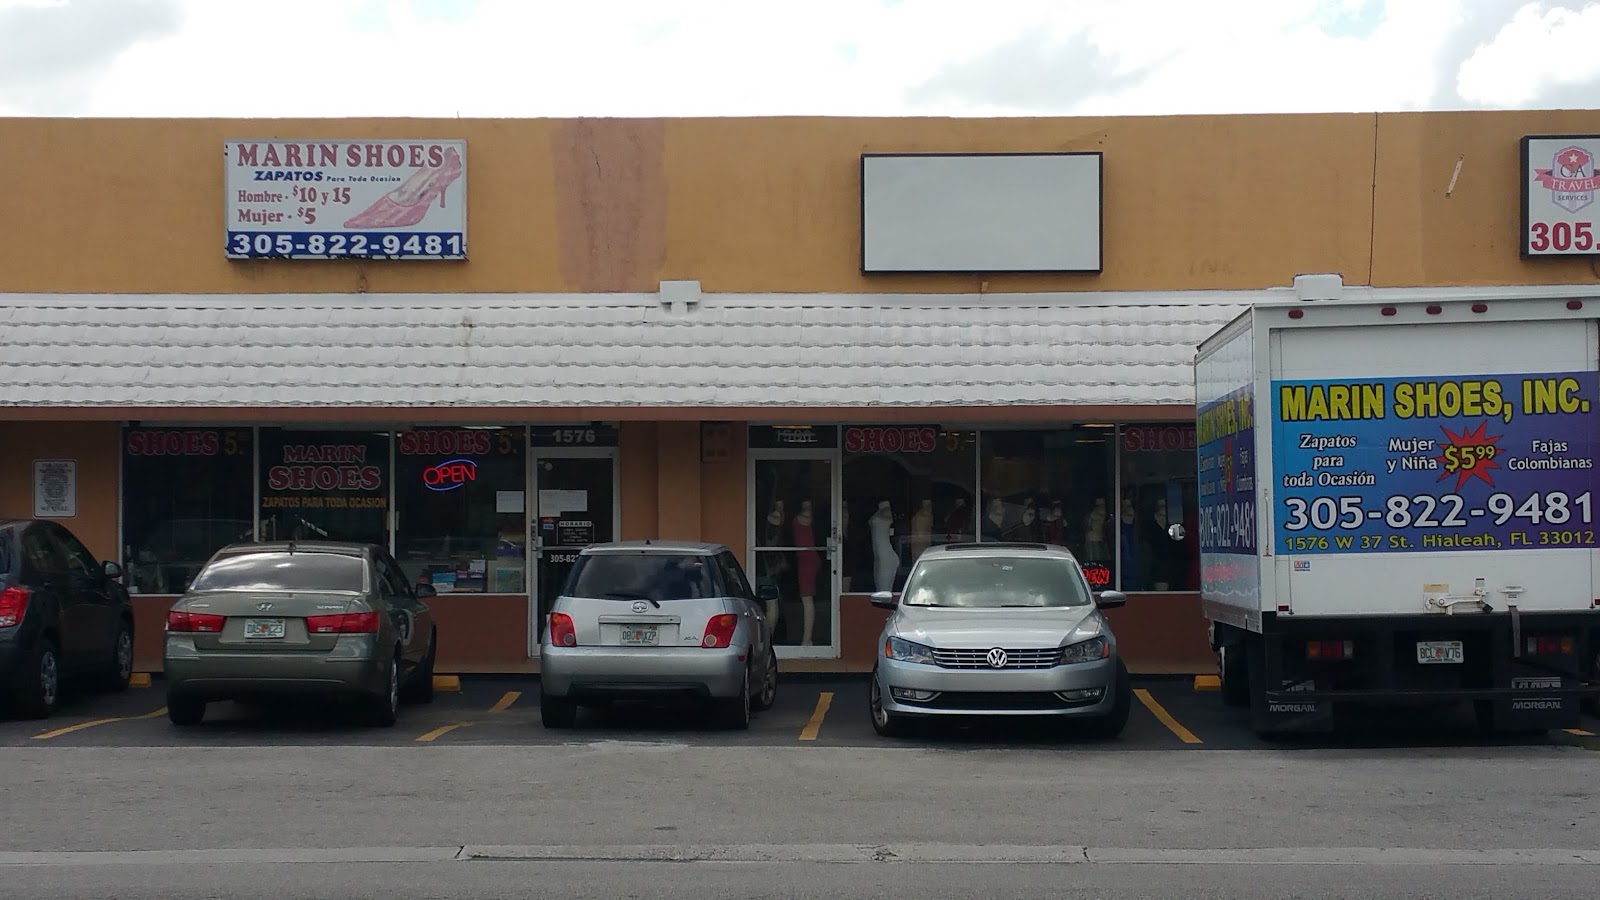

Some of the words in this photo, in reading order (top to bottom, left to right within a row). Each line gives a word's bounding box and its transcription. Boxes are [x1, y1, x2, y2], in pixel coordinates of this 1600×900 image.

[237, 144, 338, 167] MARIN
[346, 144, 443, 167] SHOES
[253, 171, 323, 182] ZAPATOS
[1551, 179, 1598, 192] TRAVEL
[238, 189, 283, 203] Hombre
[292, 185, 317, 203] $10
[321, 191, 329, 205] y
[332, 187, 351, 204] 15
[238, 209, 284, 226] Mujer
[297, 207, 316, 225] $5
[233, 235, 462, 254] 305-822-9481
[1280, 384, 1385, 422] MARIN
[1394, 379, 1513, 423] SHOES,
[1522, 378, 1590, 416] INC.
[127, 430, 219, 456] SHOES
[400, 430, 490, 455] SHOES
[552, 429, 596, 443] 1576
[845, 427, 936, 453] SHOES
[1125, 427, 1196, 452] SHOE
[1300, 434, 1356, 450] Zapatos
[282, 444, 367, 464] MARIN
[1388, 438, 1435, 454] Mujer
[1532, 440, 1568, 454] Fajas
[1312, 455, 1344, 470] para
[1387, 459, 1396, 473] y
[1402, 455, 1437, 471] Niña
[1508, 456, 1593, 471] Colombianas
[268, 465, 381, 491] SHOES
[423, 464, 476, 485] OPEN
[1283, 472, 1313, 488] toda
[1318, 471, 1376, 487] Ocasión
[262, 496, 300, 508] ZAPATOS
[302, 496, 323, 508] PARA
[325, 496, 347, 508] TODA
[349, 496, 386, 508] OCASION
[1285, 491, 1592, 531] 305-822-9481
[1285, 536, 1329, 550] 1576
[1334, 535, 1353, 549] W
[1360, 535, 1382, 549] 37
[1388, 534, 1415, 548] St.
[1422, 532, 1502, 549] Hialeah,
[1510, 532, 1533, 546] FL
[1539, 530, 1595, 545] 33012
[550, 554, 579, 563] 305-82
[1445, 647, 1461, 658] V76
[1269, 704, 1315, 712] MORGAN
[1512, 701, 1562, 709] MORGAN
